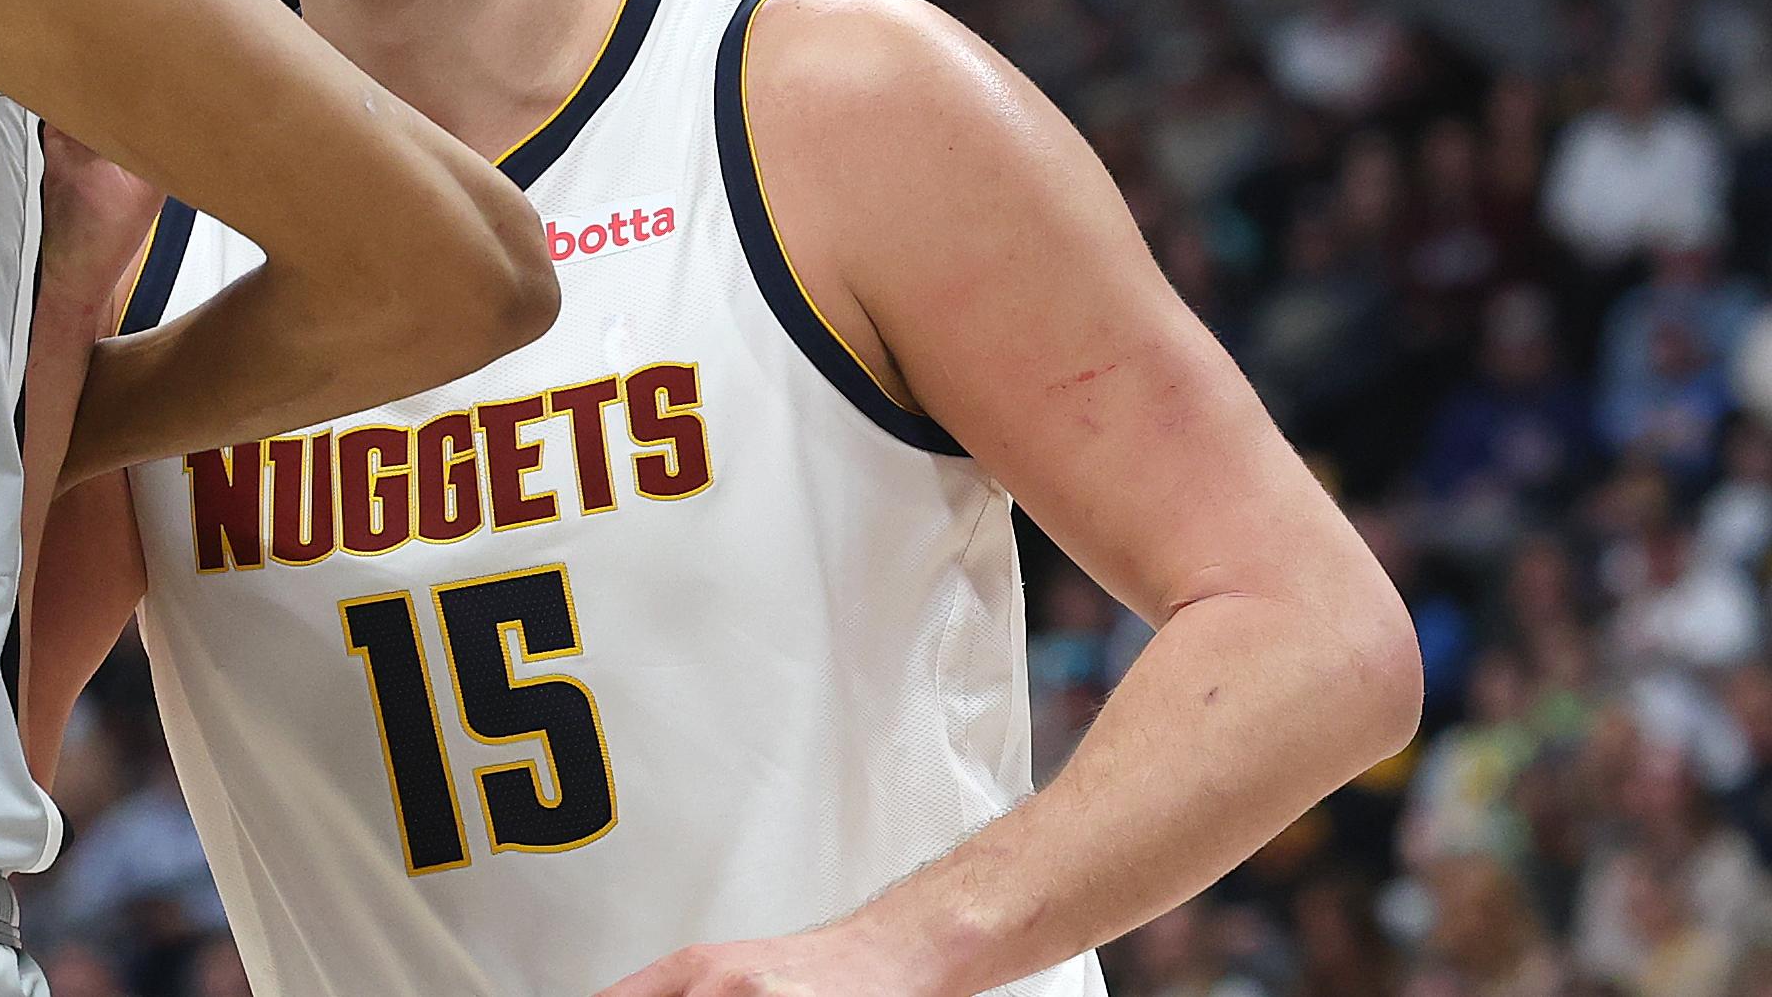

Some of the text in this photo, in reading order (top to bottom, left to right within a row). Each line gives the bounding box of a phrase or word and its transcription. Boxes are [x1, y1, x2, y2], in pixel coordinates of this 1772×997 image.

[546, 206, 676, 262] botta
[182, 361, 714, 575] NUGGETS
[338, 562, 619, 877] 15
